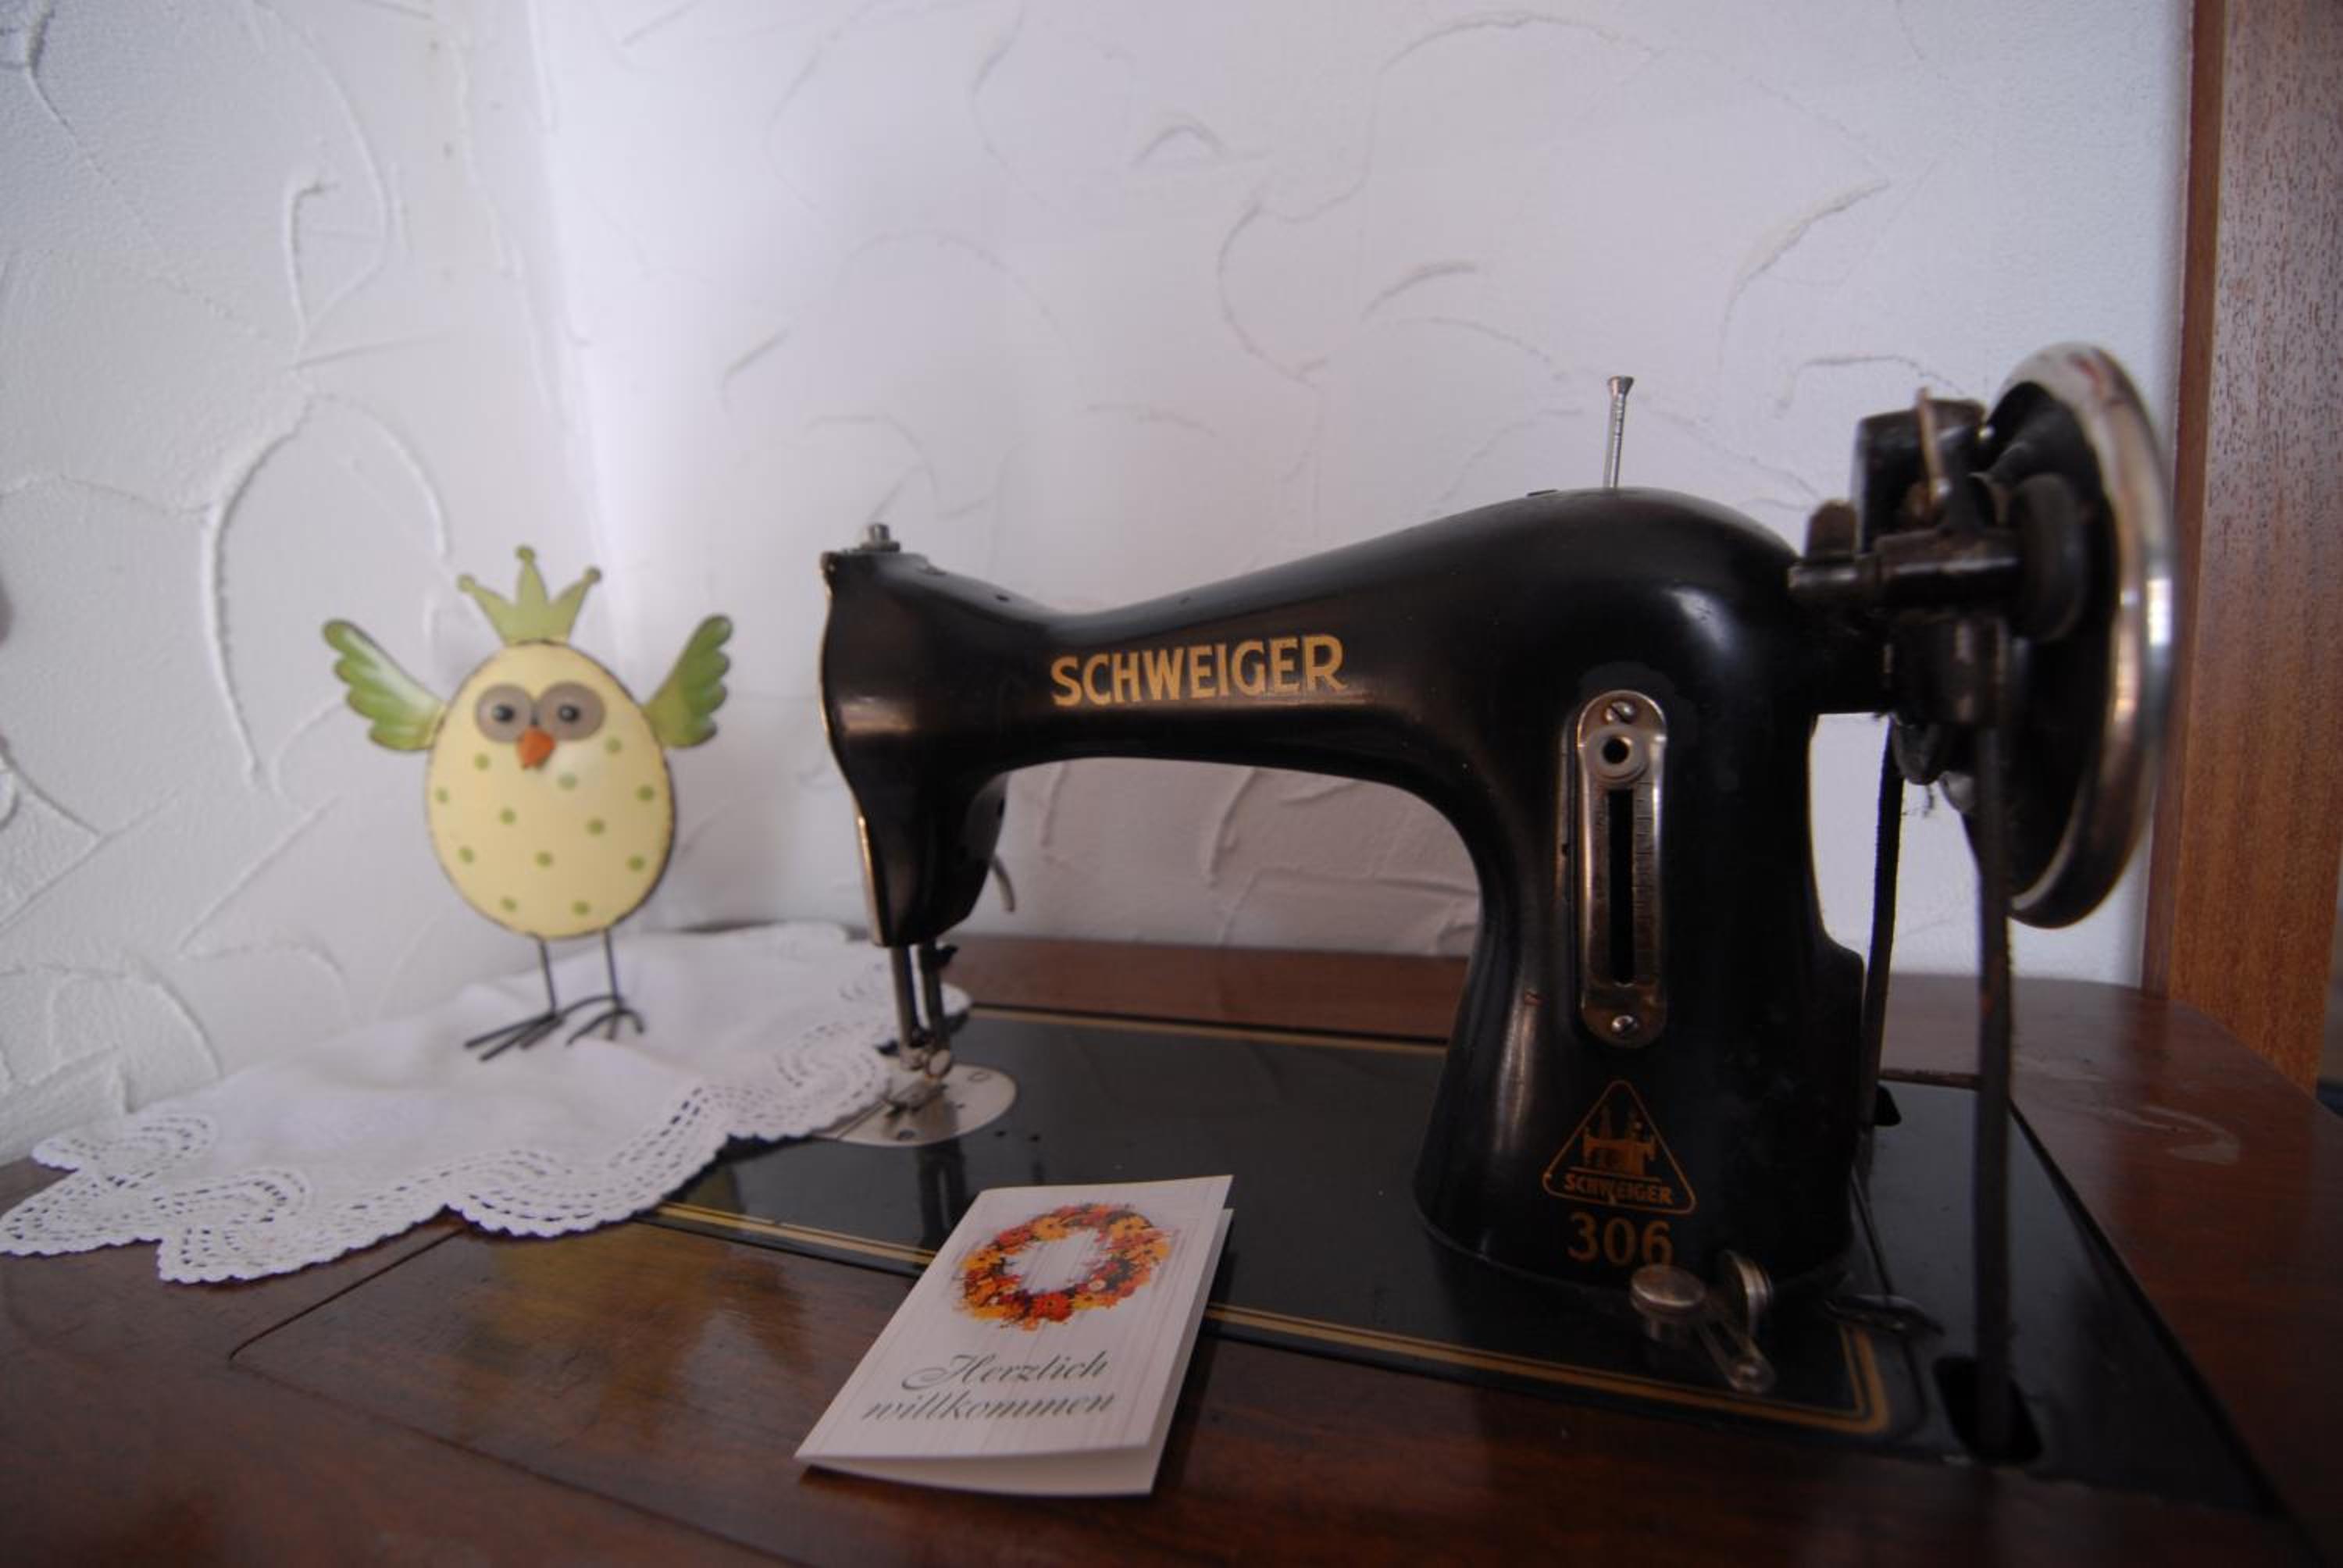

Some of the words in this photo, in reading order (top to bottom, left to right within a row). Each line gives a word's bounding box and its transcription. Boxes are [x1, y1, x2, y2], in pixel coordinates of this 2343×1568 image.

[1050, 634, 1348, 706] SCHWEIGER
[1567, 1211, 1673, 1267] 306
[901, 1350, 1108, 1391] Herzlich
[862, 1390, 1114, 1420] willkommen
